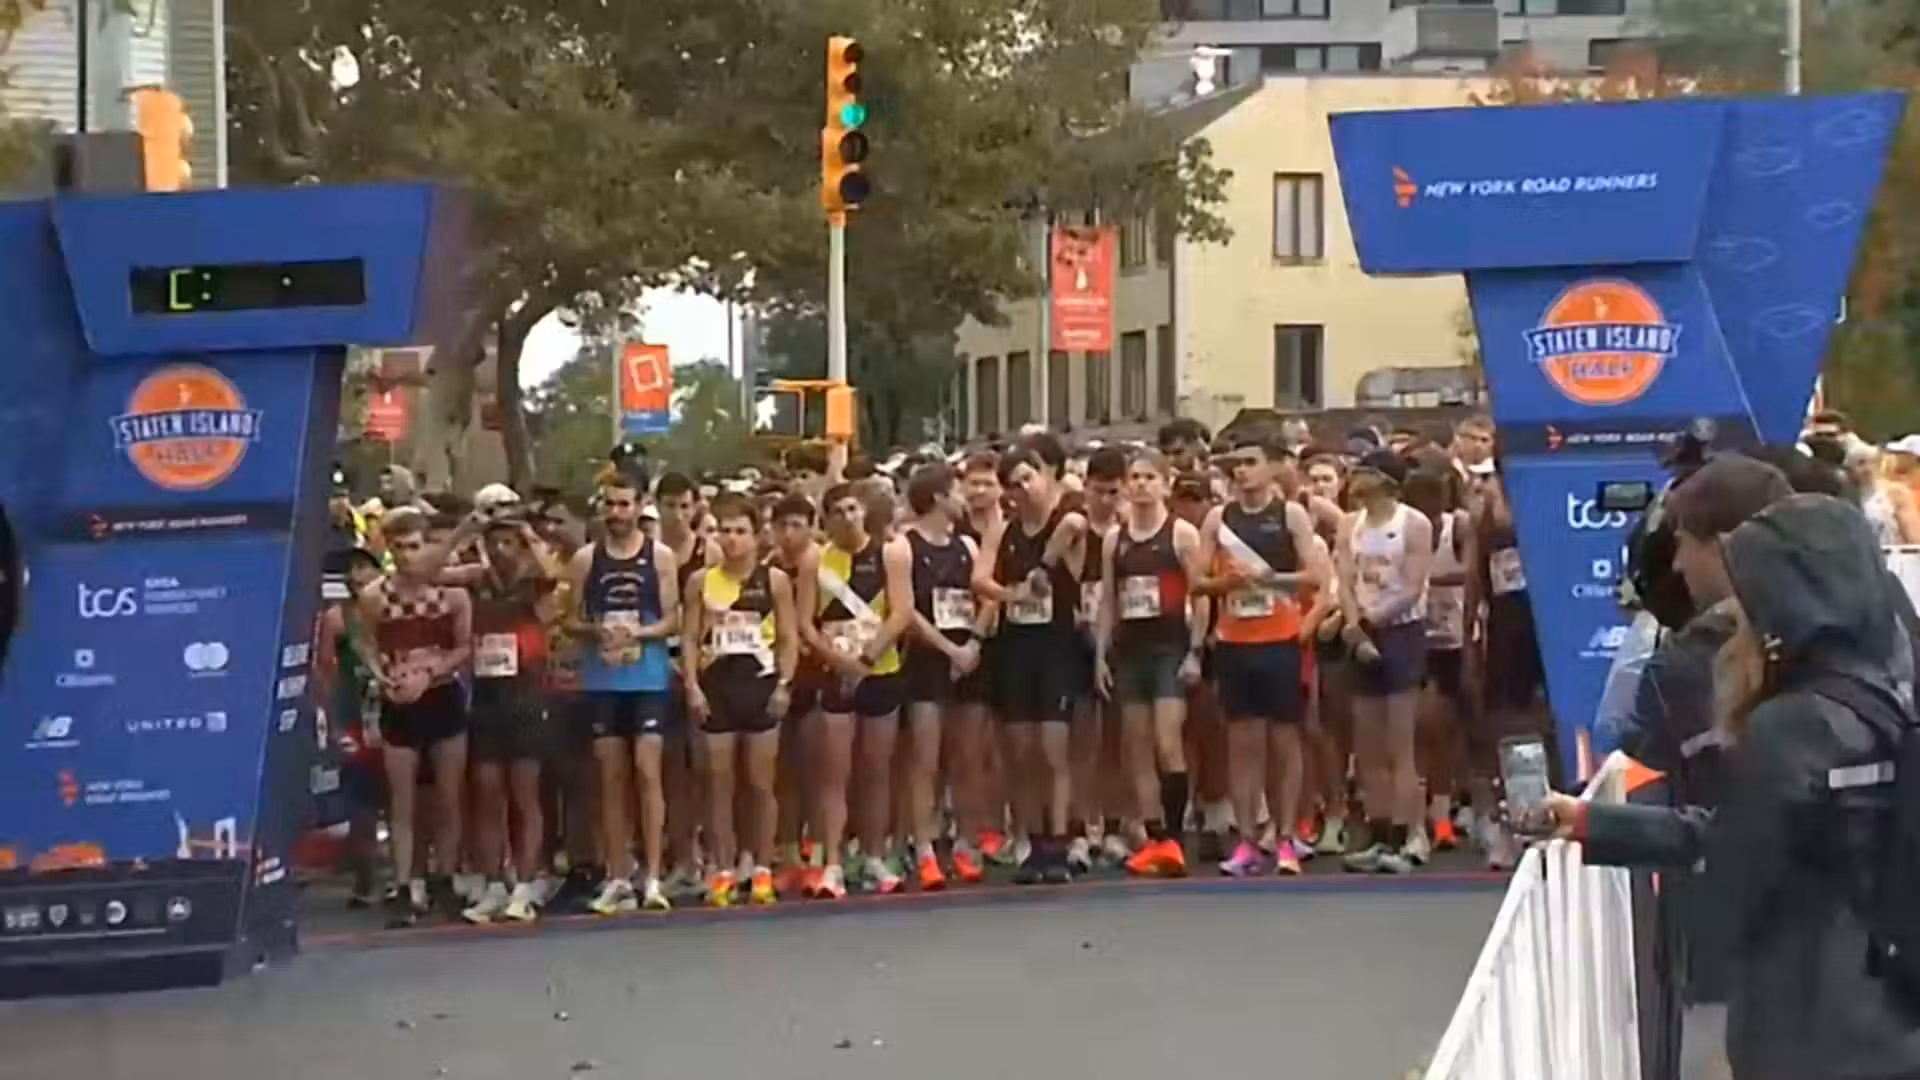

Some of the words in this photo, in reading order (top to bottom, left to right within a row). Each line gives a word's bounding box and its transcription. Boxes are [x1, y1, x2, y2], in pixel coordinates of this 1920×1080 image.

[1424, 180, 1465, 198] NEW
[1470, 179, 1516, 196] YORK
[1522, 177, 1571, 193] ROAD
[1574, 173, 1657, 192] RUNNERS
[1533, 326, 1597, 356] STATEN
[1605, 324, 1672, 351] ISLAND
[119, 414, 183, 442] STATEN
[190, 412, 253, 435] ISLAND
[78, 583, 138, 619] tcs
[126, 717, 202, 733] UNITED
